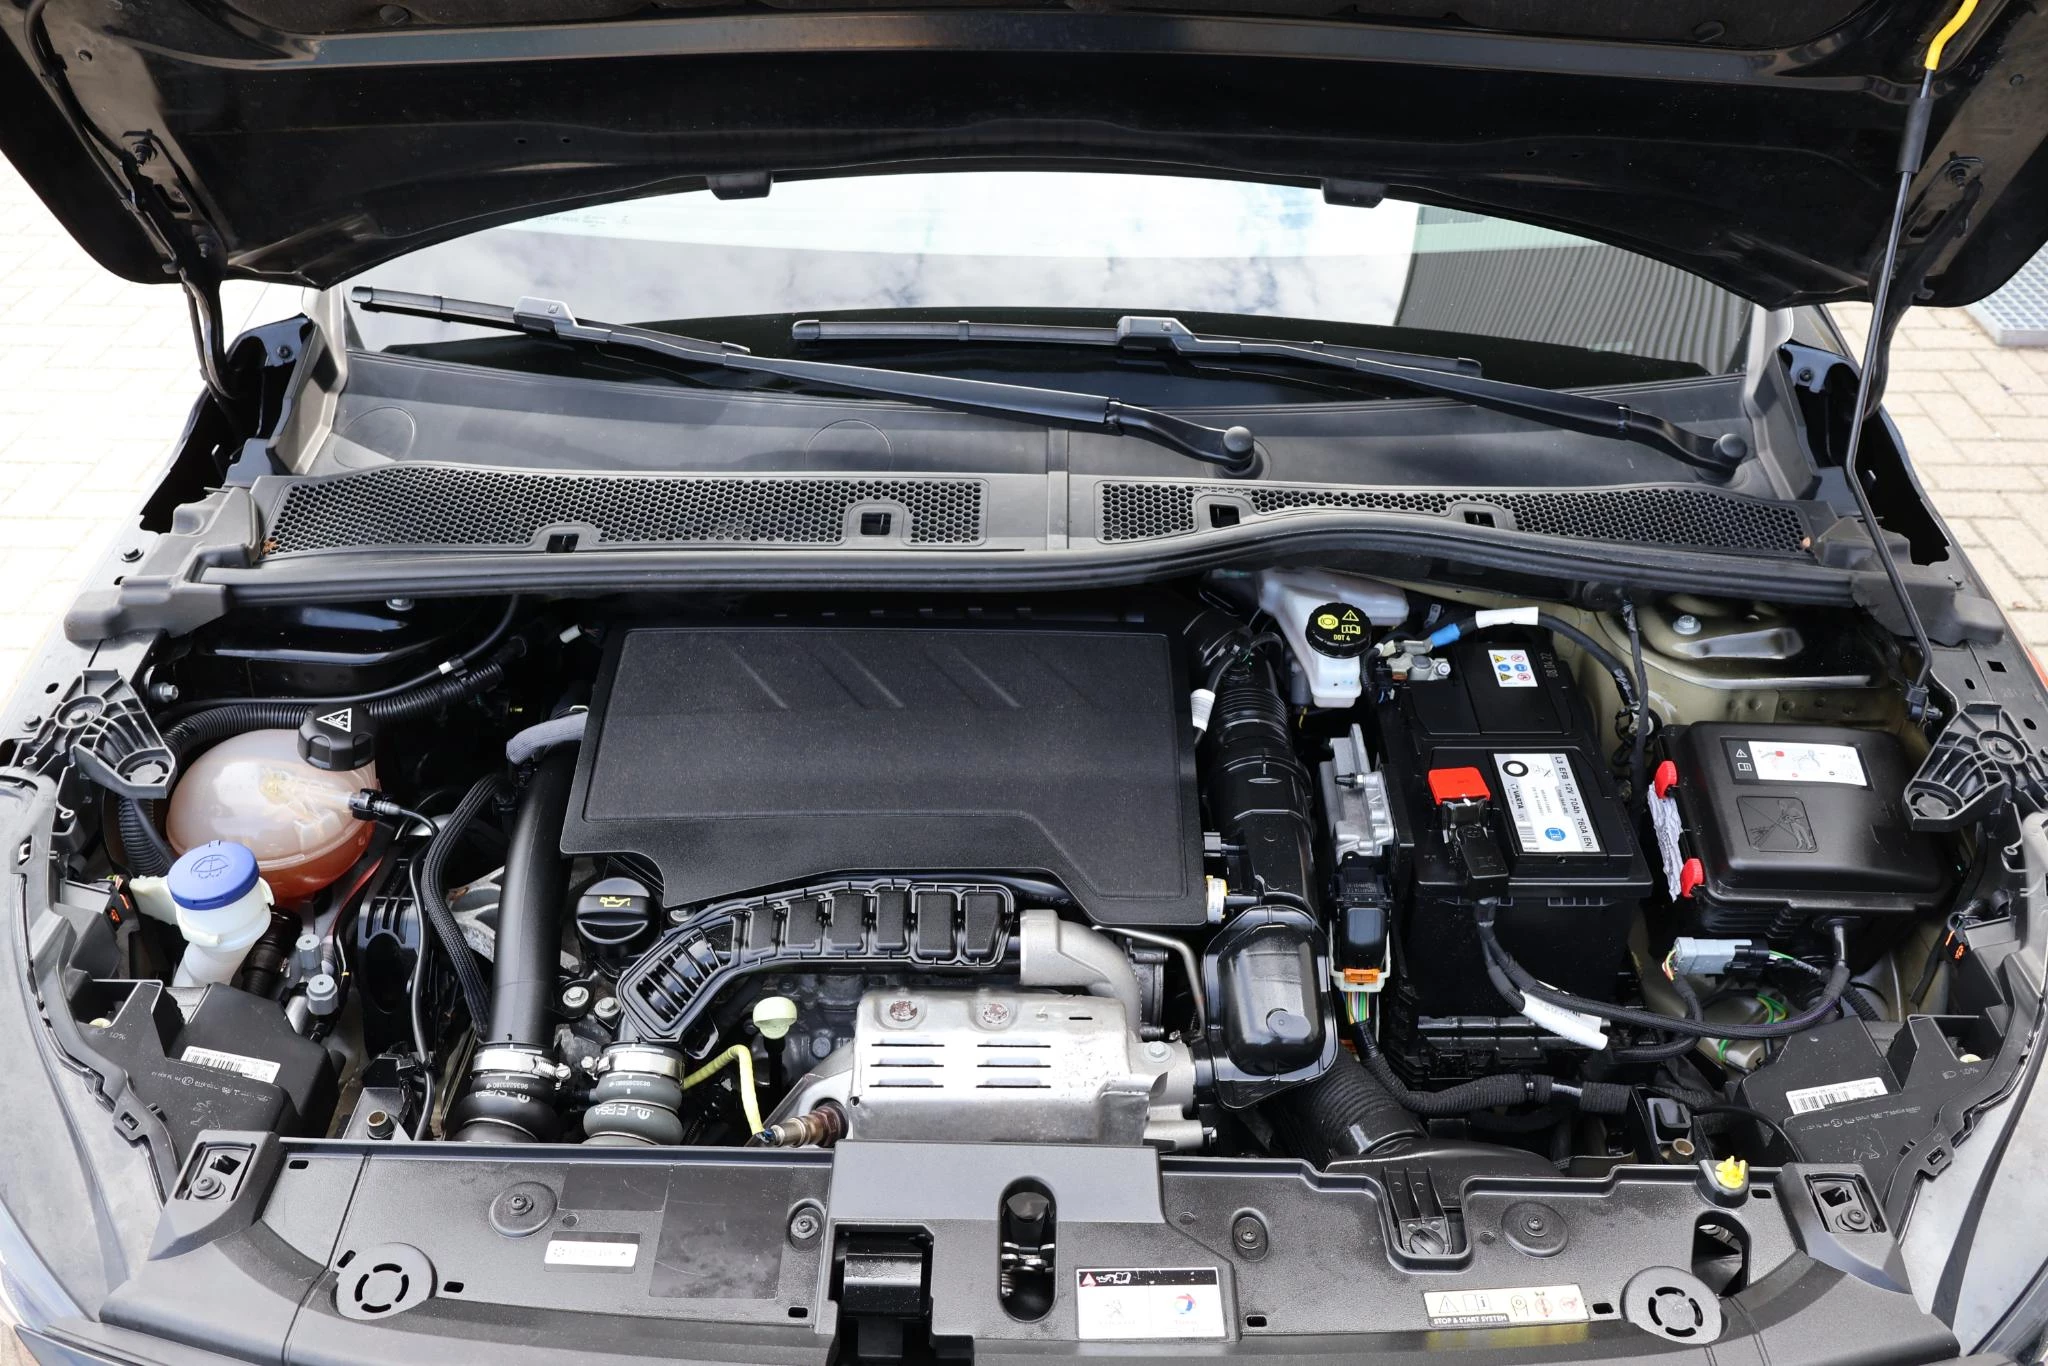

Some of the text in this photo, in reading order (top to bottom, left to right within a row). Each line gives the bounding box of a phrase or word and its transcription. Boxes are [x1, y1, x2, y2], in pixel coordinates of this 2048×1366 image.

[1513, 790, 1524, 810] VARTA
[1558, 767, 1569, 780] EFB
[1564, 783, 1575, 794] 12V
[1570, 798, 1580, 814] 70Ah
[1577, 817, 1589, 834] 760A
[1433, 1317, 1452, 1325] STOP
[1459, 1316, 1480, 1324] START
[1480, 1314, 1507, 1323] SYSTEM
